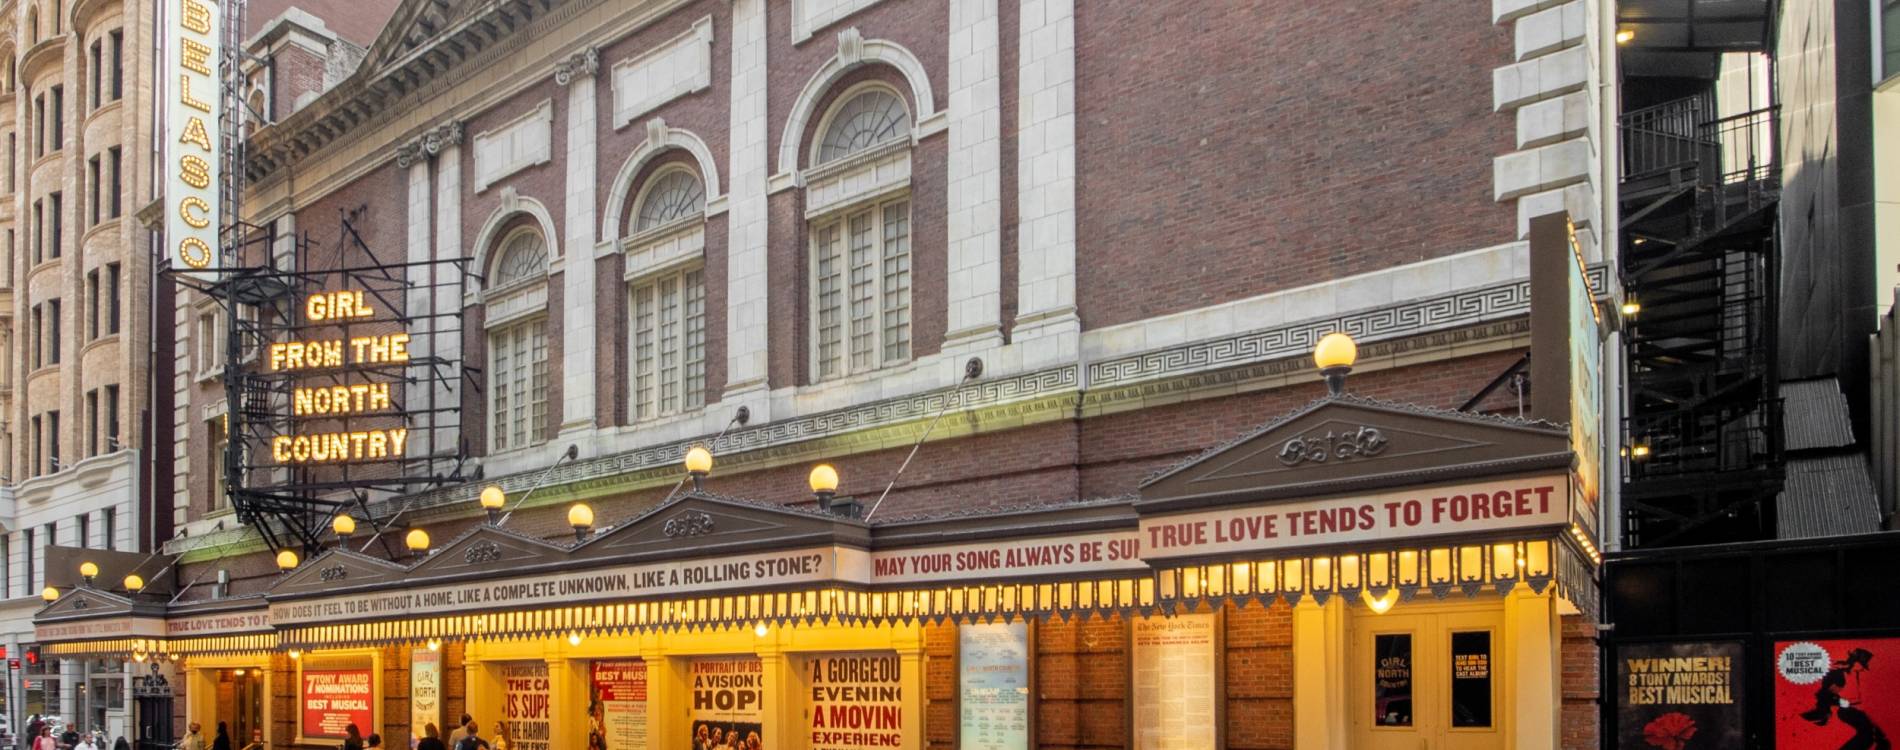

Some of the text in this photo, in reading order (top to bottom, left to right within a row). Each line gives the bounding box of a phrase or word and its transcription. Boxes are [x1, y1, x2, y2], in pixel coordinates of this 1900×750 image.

[180, 0, 211, 269] BELASCO
[307, 291, 374, 320] GIRL
[271, 333, 410, 370] FROM THE
[294, 383, 389, 415] NORTH
[273, 429, 407, 462] COUNTRY
[1148, 486, 1554, 548] TRUE LOVE TENDS TO FORGET
[874, 557, 906, 577] MAY
[910, 554, 951, 574] YOUR
[956, 550, 1000, 571] SONG
[1005, 543, 1074, 569] ALWAYS
[1079, 542, 1102, 563] BE
[273, 554, 822, 620] HOW DOES IT FEEL TO BE WITHOUT A HOME, LIKE A COMPLETE UNKNOWN, LIKE A ROLLING STONE?
[168, 621, 189, 632] TRUE
[191, 619, 212, 631] LOVE
[215, 617, 245, 630] TENDS
[248, 616, 260, 626] TO
[1168, 621, 1185, 632] York
[1187, 621, 1209, 629] Times
[1627, 656, 1731, 673] WINNER!
[1786, 652, 1795, 661] 10
[596, 662, 601, 671] 7
[700, 662, 735, 673] PORTRAIT
[737, 661, 747, 672] OF
[828, 656, 901, 684] GORGEOU
[1377, 669, 1409, 678] NORTH
[306, 673, 369, 694] 7 TONY AWARD
[418, 671, 434, 683] GIRL
[595, 671, 620, 681] BEST
[694, 675, 703, 688] A
[706, 675, 754, 688] VISION
[1629, 674, 1637, 686] 8
[1640, 673, 1670, 686] TONY
[315, 683, 369, 694] NOMINATIONS
[415, 687, 436, 698] NORTH
[507, 679, 549, 691] THE CA
[1629, 686, 1734, 705] BEST MUSICAL
[307, 699, 368, 710] BEST MUSICAL
[507, 694, 518, 719] IS
[813, 704, 901, 730] A MOVIN
[508, 721, 549, 741] THE HARMO
[812, 732, 900, 747] EXPERIENC
